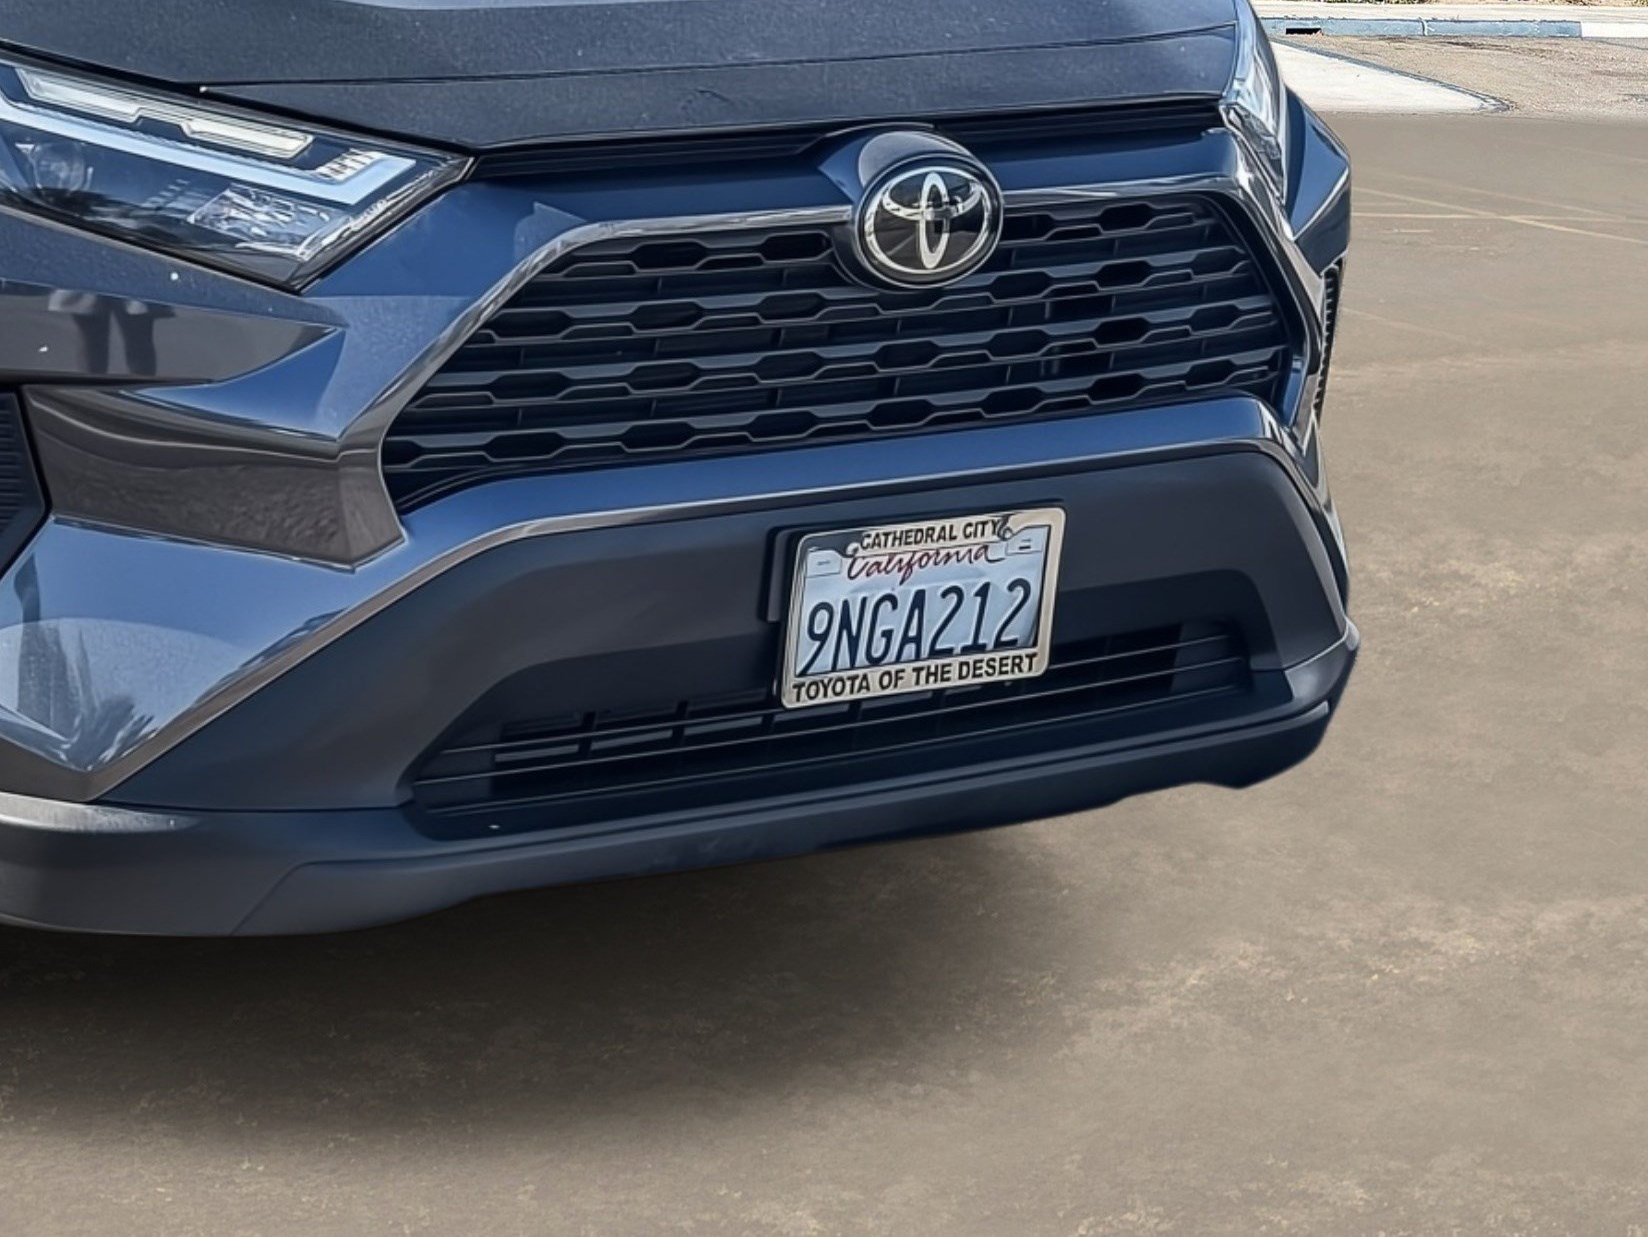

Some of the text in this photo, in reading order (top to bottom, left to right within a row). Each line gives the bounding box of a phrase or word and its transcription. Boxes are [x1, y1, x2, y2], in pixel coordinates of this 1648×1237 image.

[860, 518, 1000, 552] CATHEDRAL CITY
[846, 543, 1007, 586] California
[795, 577, 1032, 679] 9NGA212
[792, 652, 1039, 703] TOYOTA OF THE DESERT
